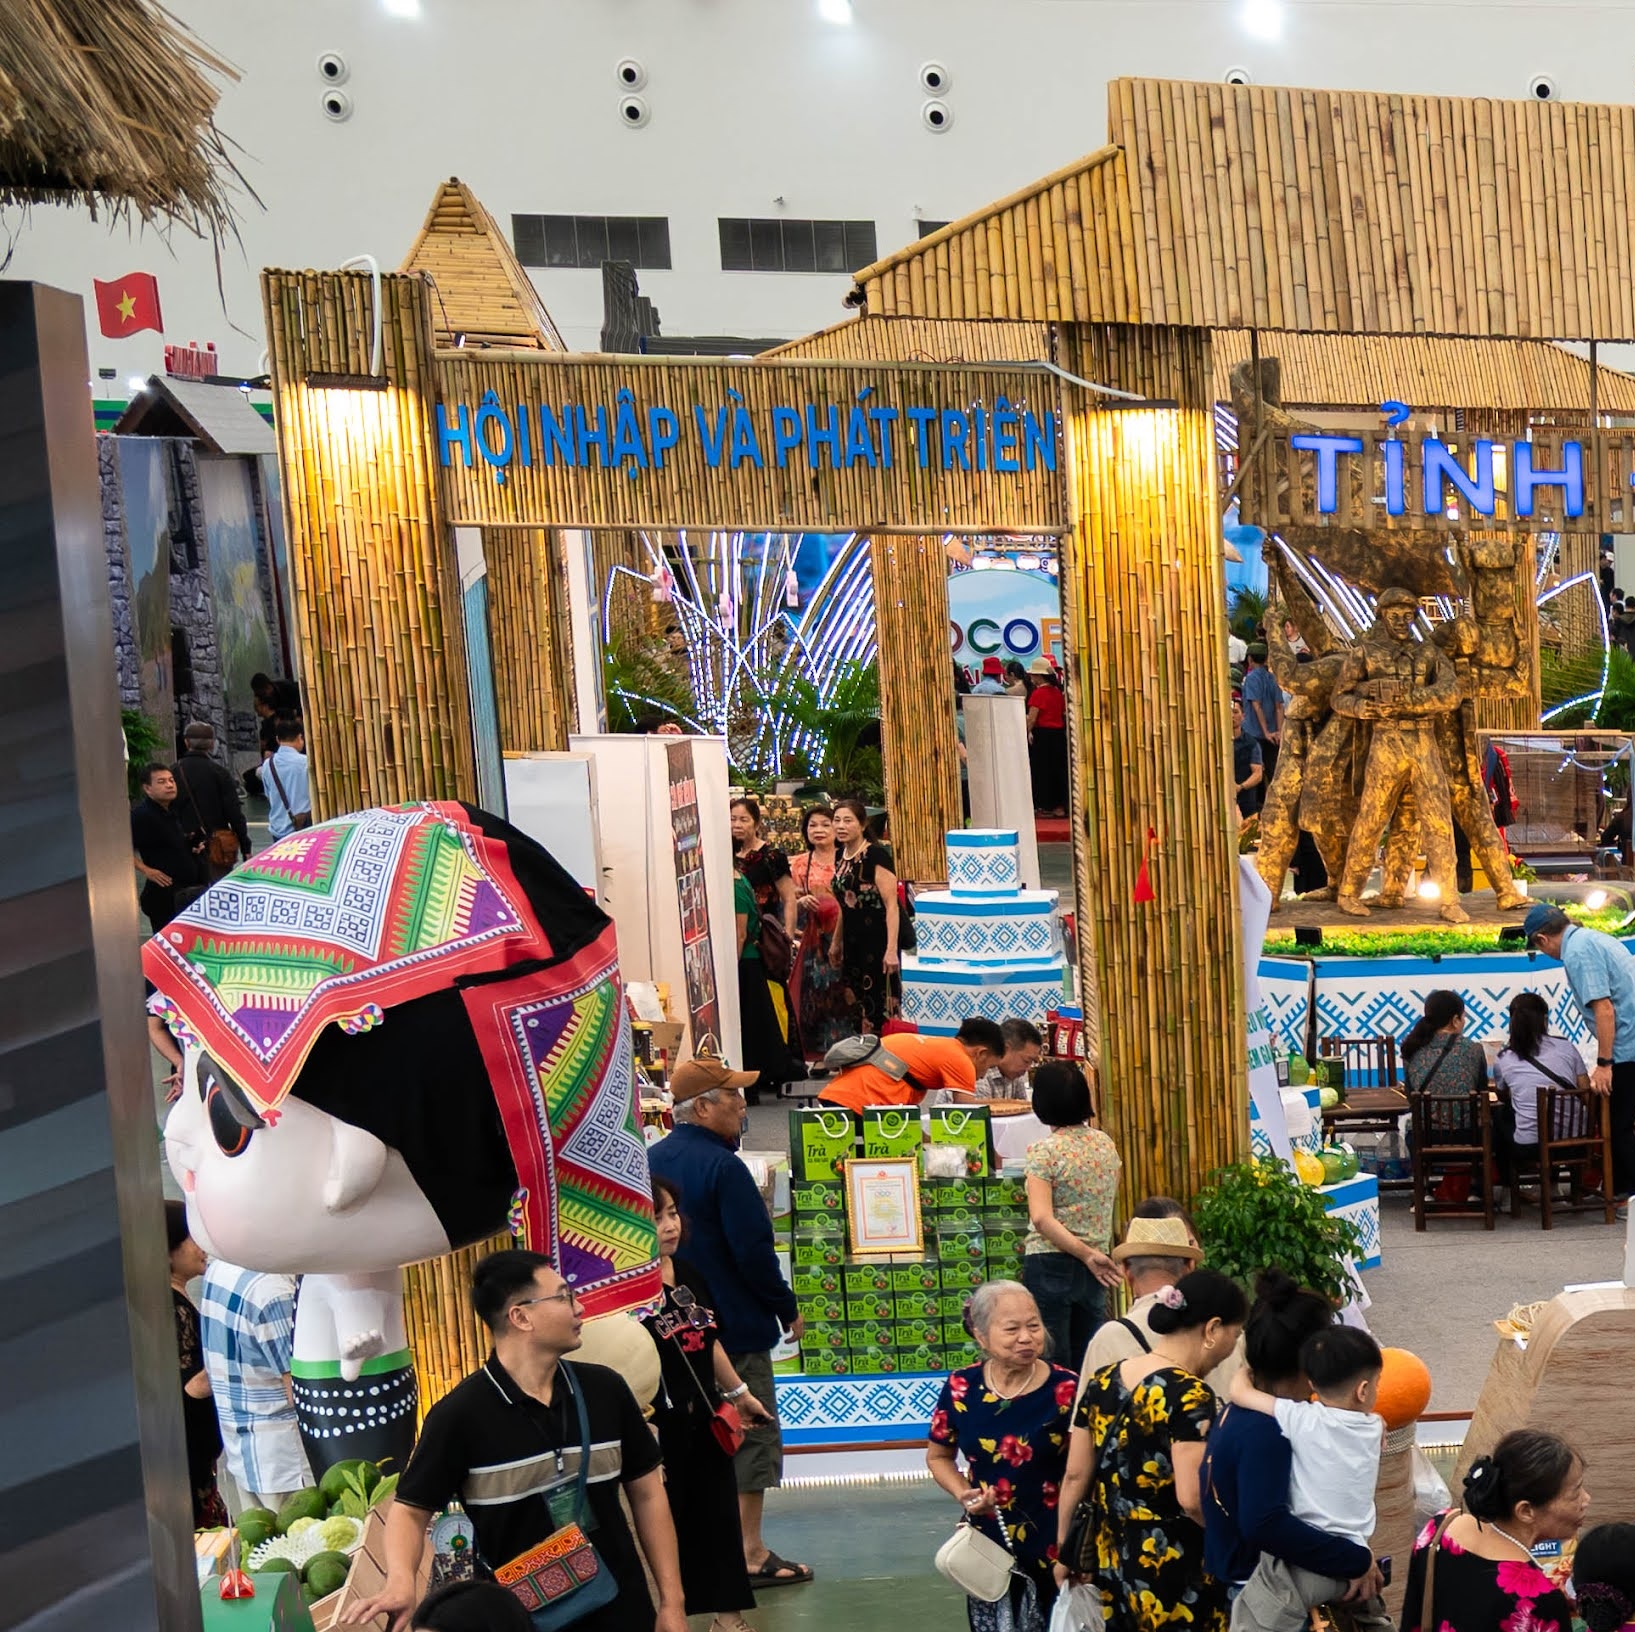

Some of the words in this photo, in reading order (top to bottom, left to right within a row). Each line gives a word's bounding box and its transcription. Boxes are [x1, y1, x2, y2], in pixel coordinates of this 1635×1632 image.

[435, 389, 531, 485] HỘI
[541, 388, 679, 481] NHẬP
[695, 388, 763, 469] VÀ
[773, 387, 898, 469] PHÁT
[1291, 400, 1585, 517] TỈNH
[807, 1144, 827, 1157] Trà
[868, 1142, 889, 1155] Trà
